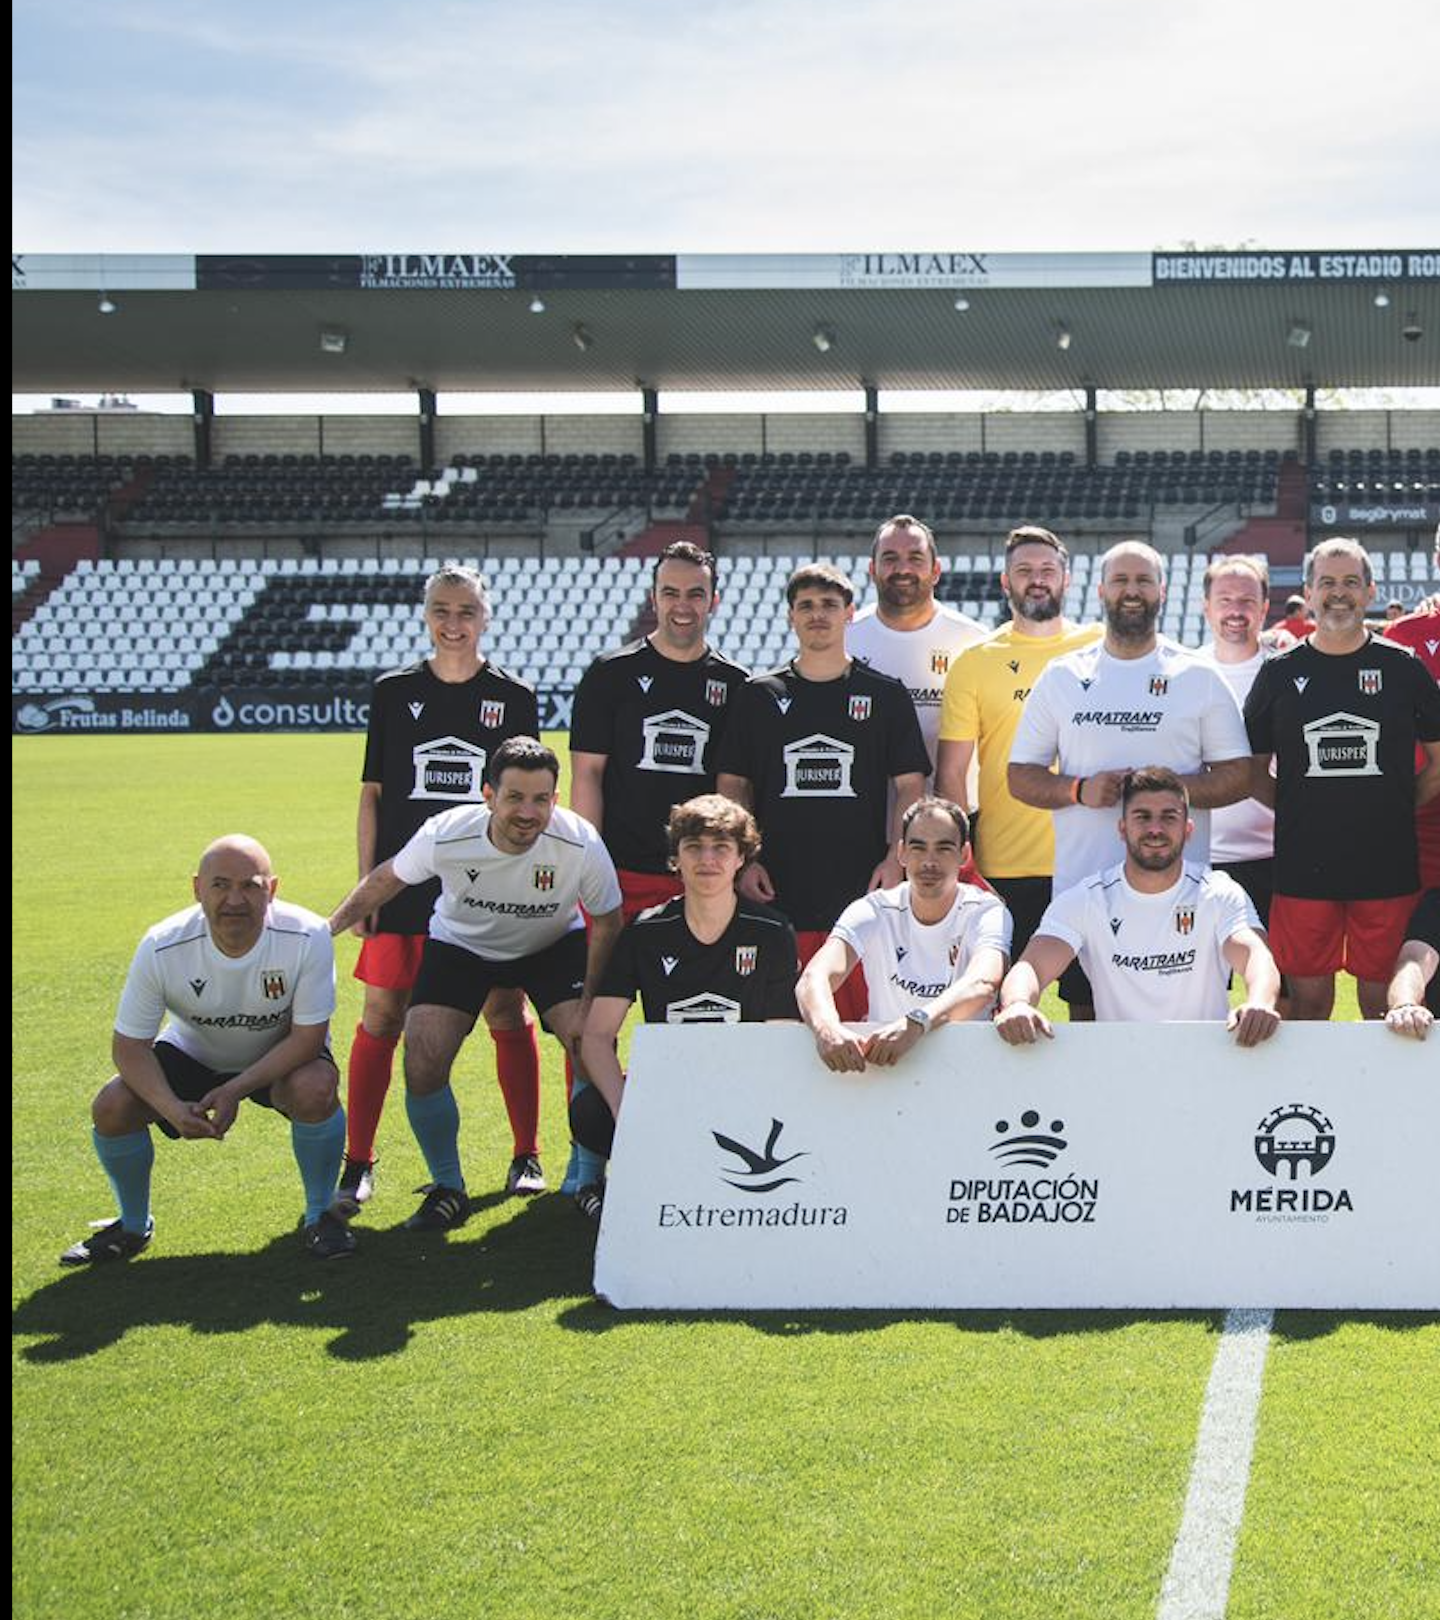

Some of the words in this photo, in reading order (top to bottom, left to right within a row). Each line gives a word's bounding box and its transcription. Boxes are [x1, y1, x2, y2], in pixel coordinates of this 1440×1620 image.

[361, 254, 516, 278] FILMAEX
[840, 253, 988, 277] FILMAEX
[1155, 256, 1286, 279] BIENVENIDOS
[1289, 256, 1315, 278] AL
[1319, 255, 1402, 278] ESTADIO
[59, 708, 117, 728] Frutas
[121, 708, 191, 728] Belinda
[1072, 711, 1164, 726] RARATRANS
[1111, 949, 1197, 972] RARATRANS
[948, 1173, 1099, 1201] DIPUTACIÓN
[1230, 1186, 1354, 1212] MÉRIDA
[658, 1203, 847, 1228] Extremadura
[946, 1208, 970, 1223] DE
[976, 1202, 1097, 1224] BADAJOZ
[1255, 1215, 1329, 1224] AYUNTAMIENTO
